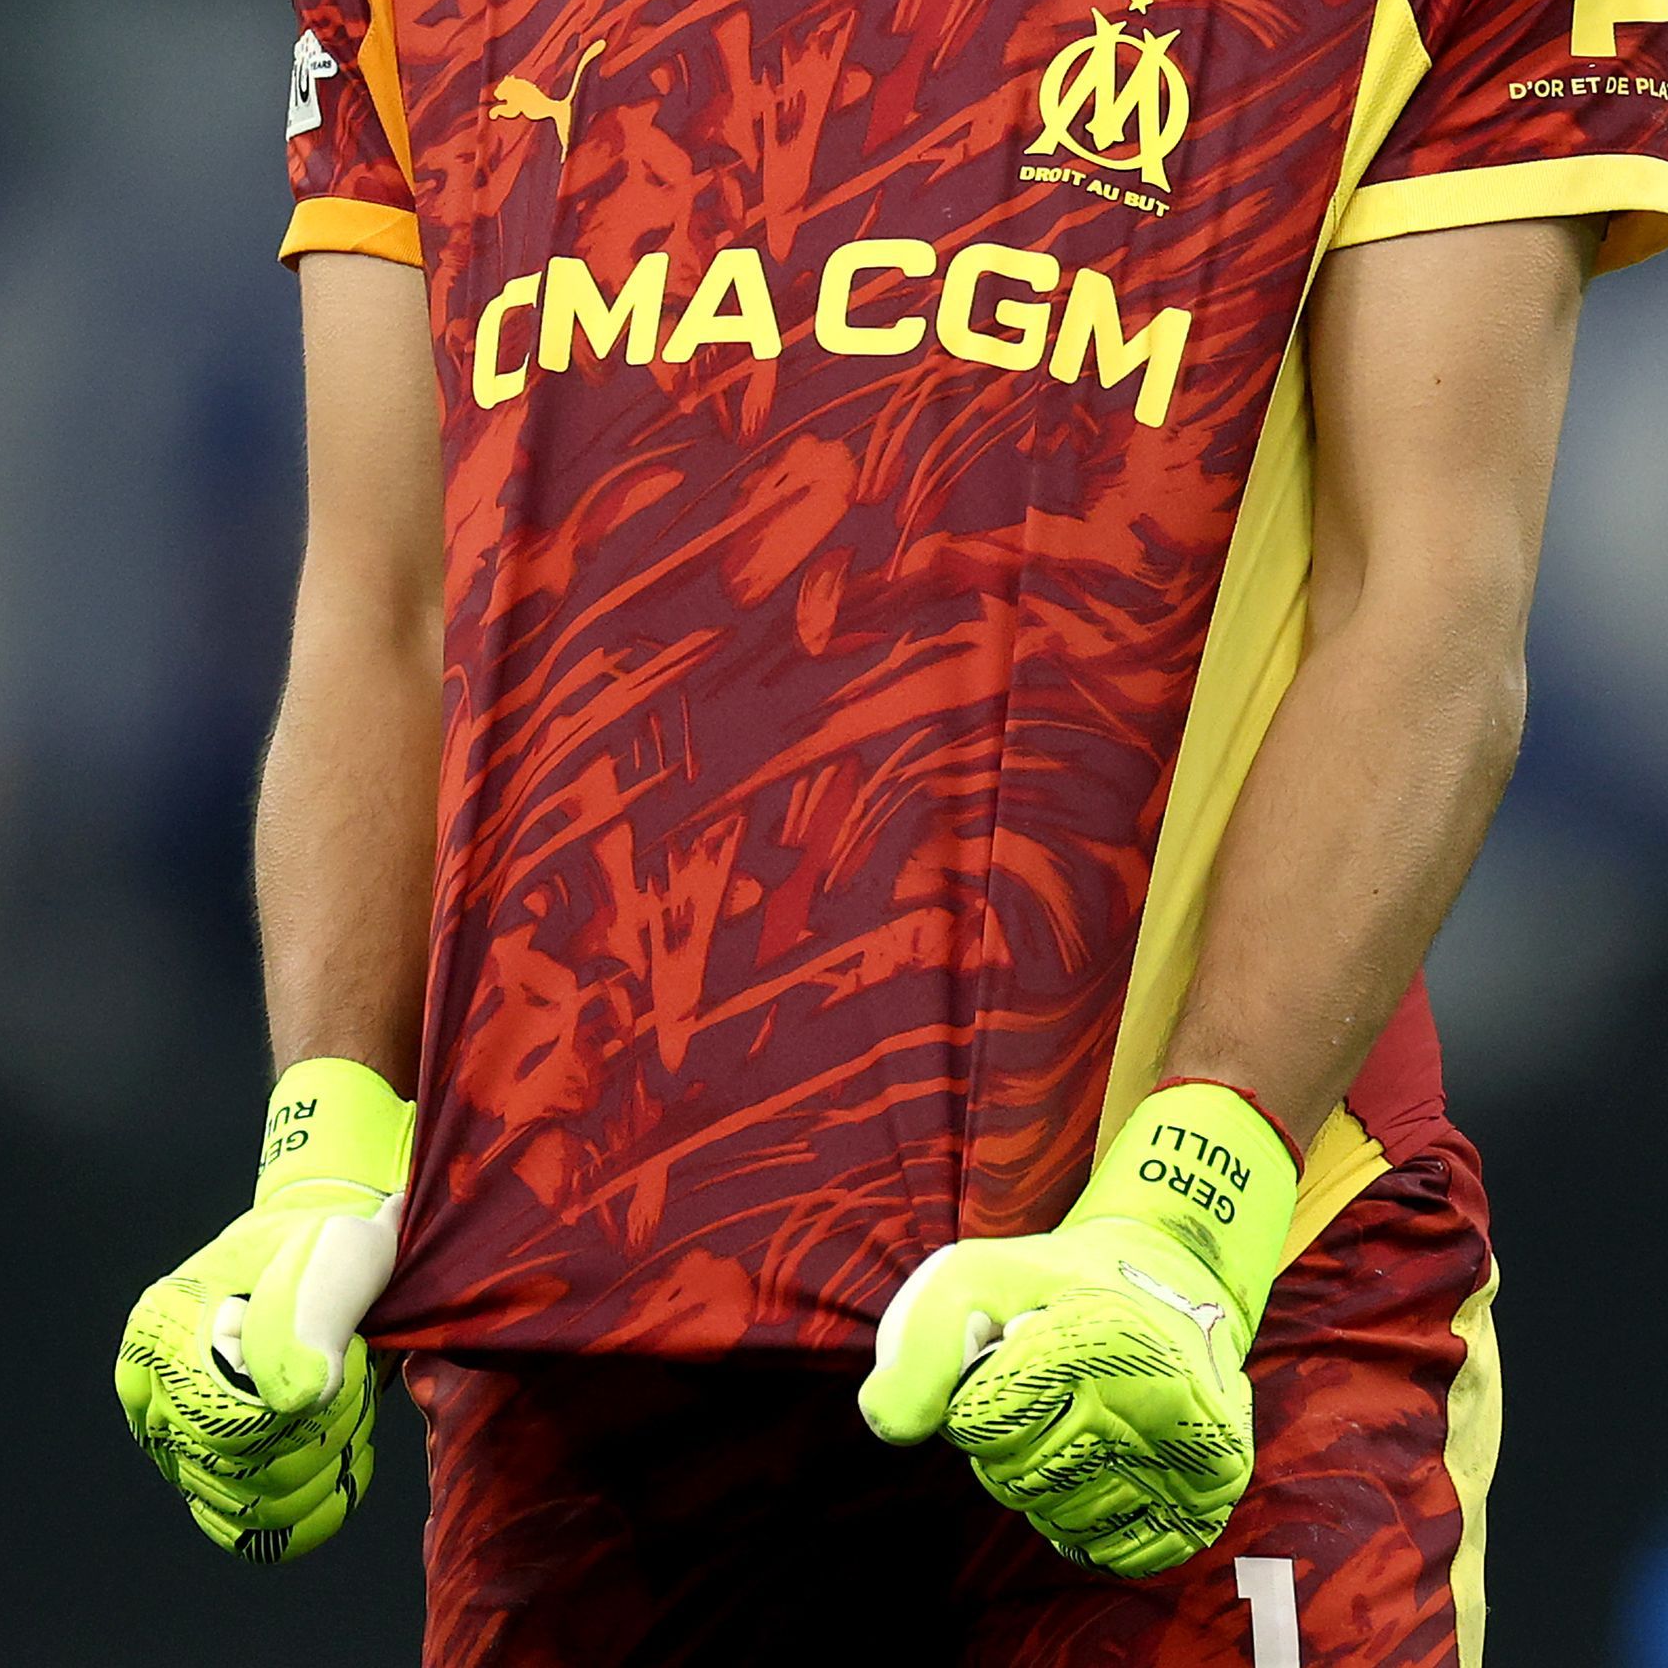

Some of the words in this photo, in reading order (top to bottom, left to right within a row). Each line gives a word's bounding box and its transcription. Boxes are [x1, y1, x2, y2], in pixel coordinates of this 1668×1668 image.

[1570, 76, 1601, 95] ET
[1605, 76, 1630, 95] DE
[1019, 165, 1087, 187] DROIT
[1085, 179, 1121, 201] AU
[1123, 190, 1171, 218] BUT
[471, 247, 784, 411] CMA
[813, 238, 1193, 429] CGM
[1138, 1158, 1236, 1226] GERO
[1150, 1124, 1251, 1194] RULLI
[1234, 1556, 1301, 1668] 1
